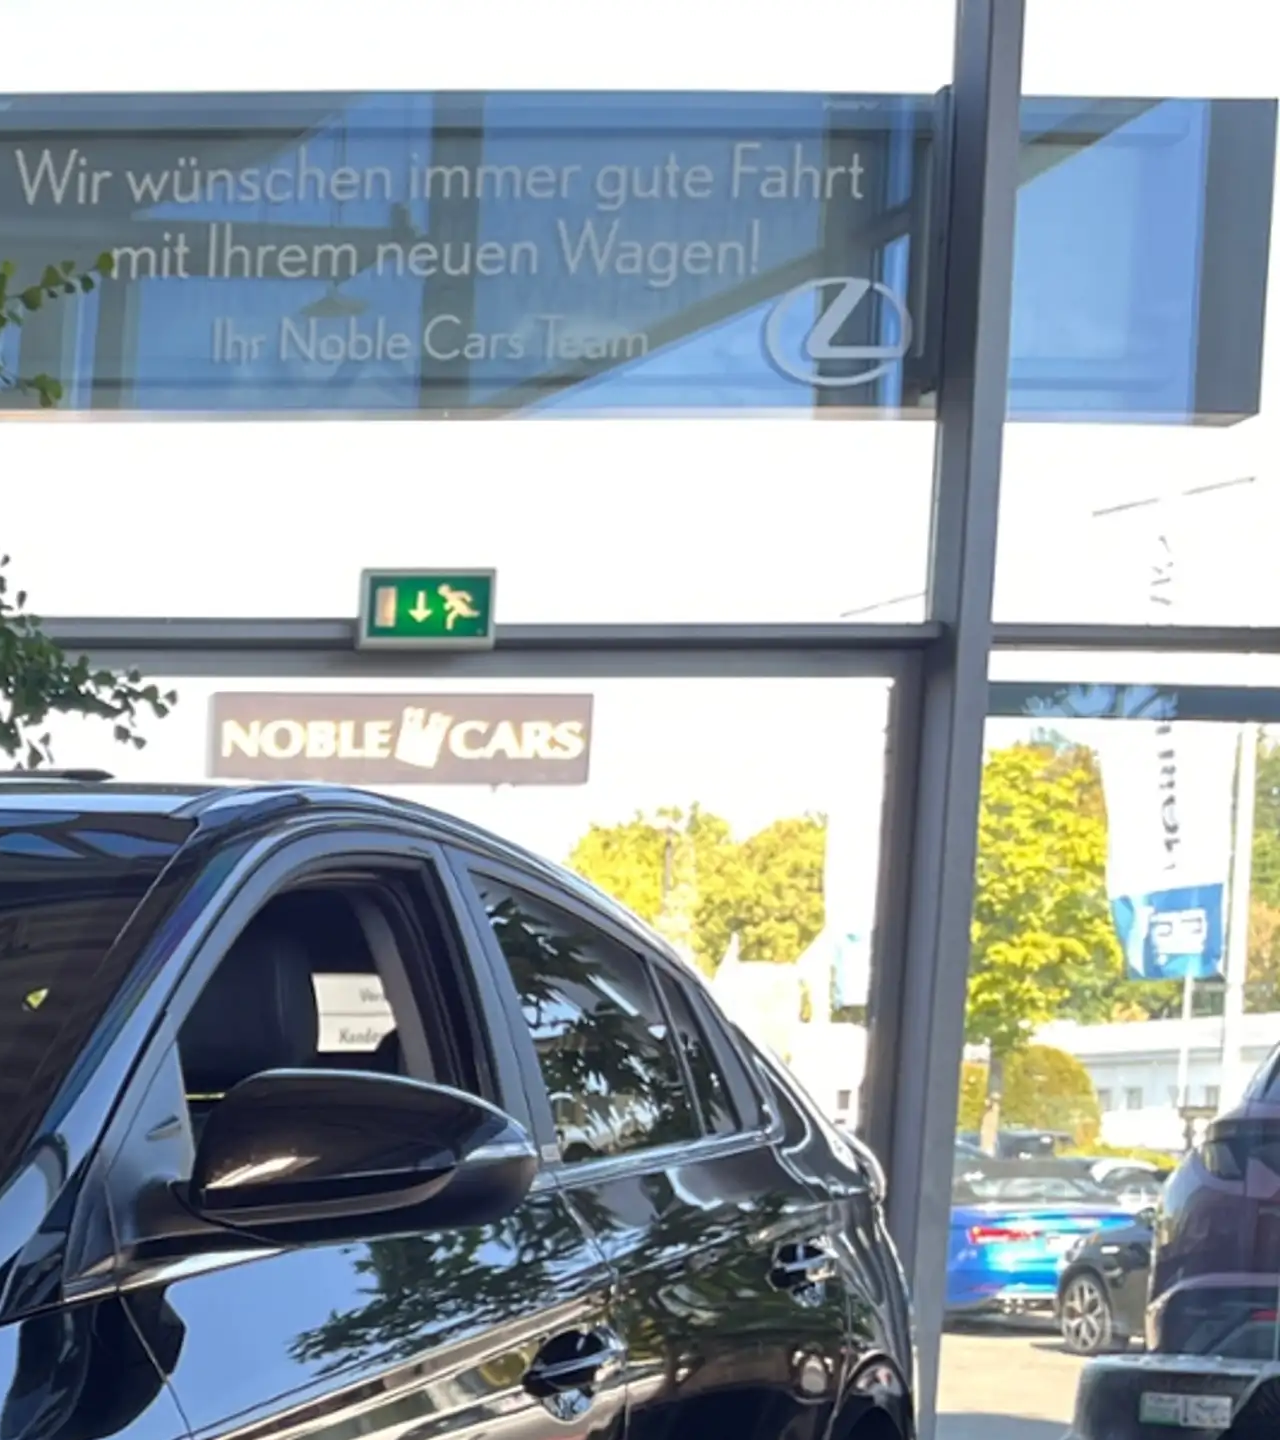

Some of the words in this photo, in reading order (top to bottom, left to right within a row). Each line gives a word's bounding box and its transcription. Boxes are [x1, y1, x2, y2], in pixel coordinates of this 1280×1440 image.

[14, 148, 113, 205] Wir
[125, 144, 391, 205] wünschen
[408, 151, 581, 200] immer
[594, 151, 714, 212] gute
[731, 142, 865, 200] Fahrt
[109, 231, 190, 281] mit
[208, 221, 365, 279] Ihrem
[375, 238, 539, 278] neuen
[556, 218, 761, 288] Wagen!
[212, 316, 267, 363] Ihr
[280, 315, 412, 363] Noble
[423, 314, 526, 361] Cars
[537, 313, 649, 361] Team
[220, 718, 394, 760] NOBLE
[448, 719, 586, 760] CARS
